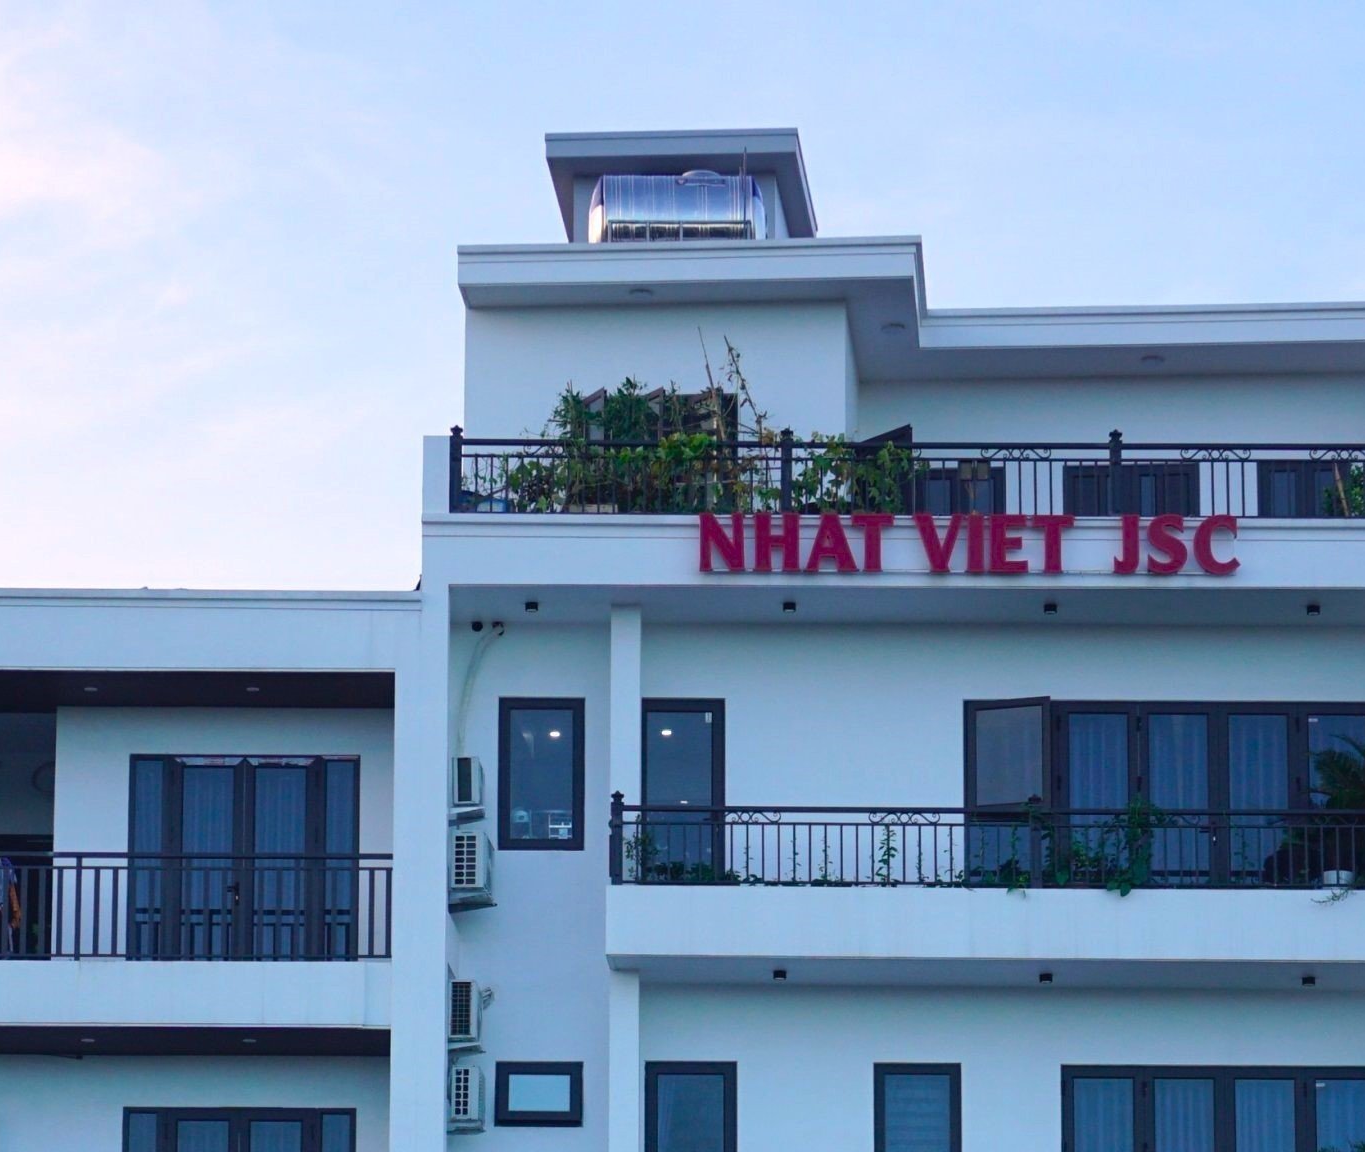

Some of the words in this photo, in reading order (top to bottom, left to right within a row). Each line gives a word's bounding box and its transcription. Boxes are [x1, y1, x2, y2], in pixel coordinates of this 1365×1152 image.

[698, 512, 894, 573] NHAT
[913, 512, 1075, 574] VIET
[1113, 513, 1241, 576] JSC
